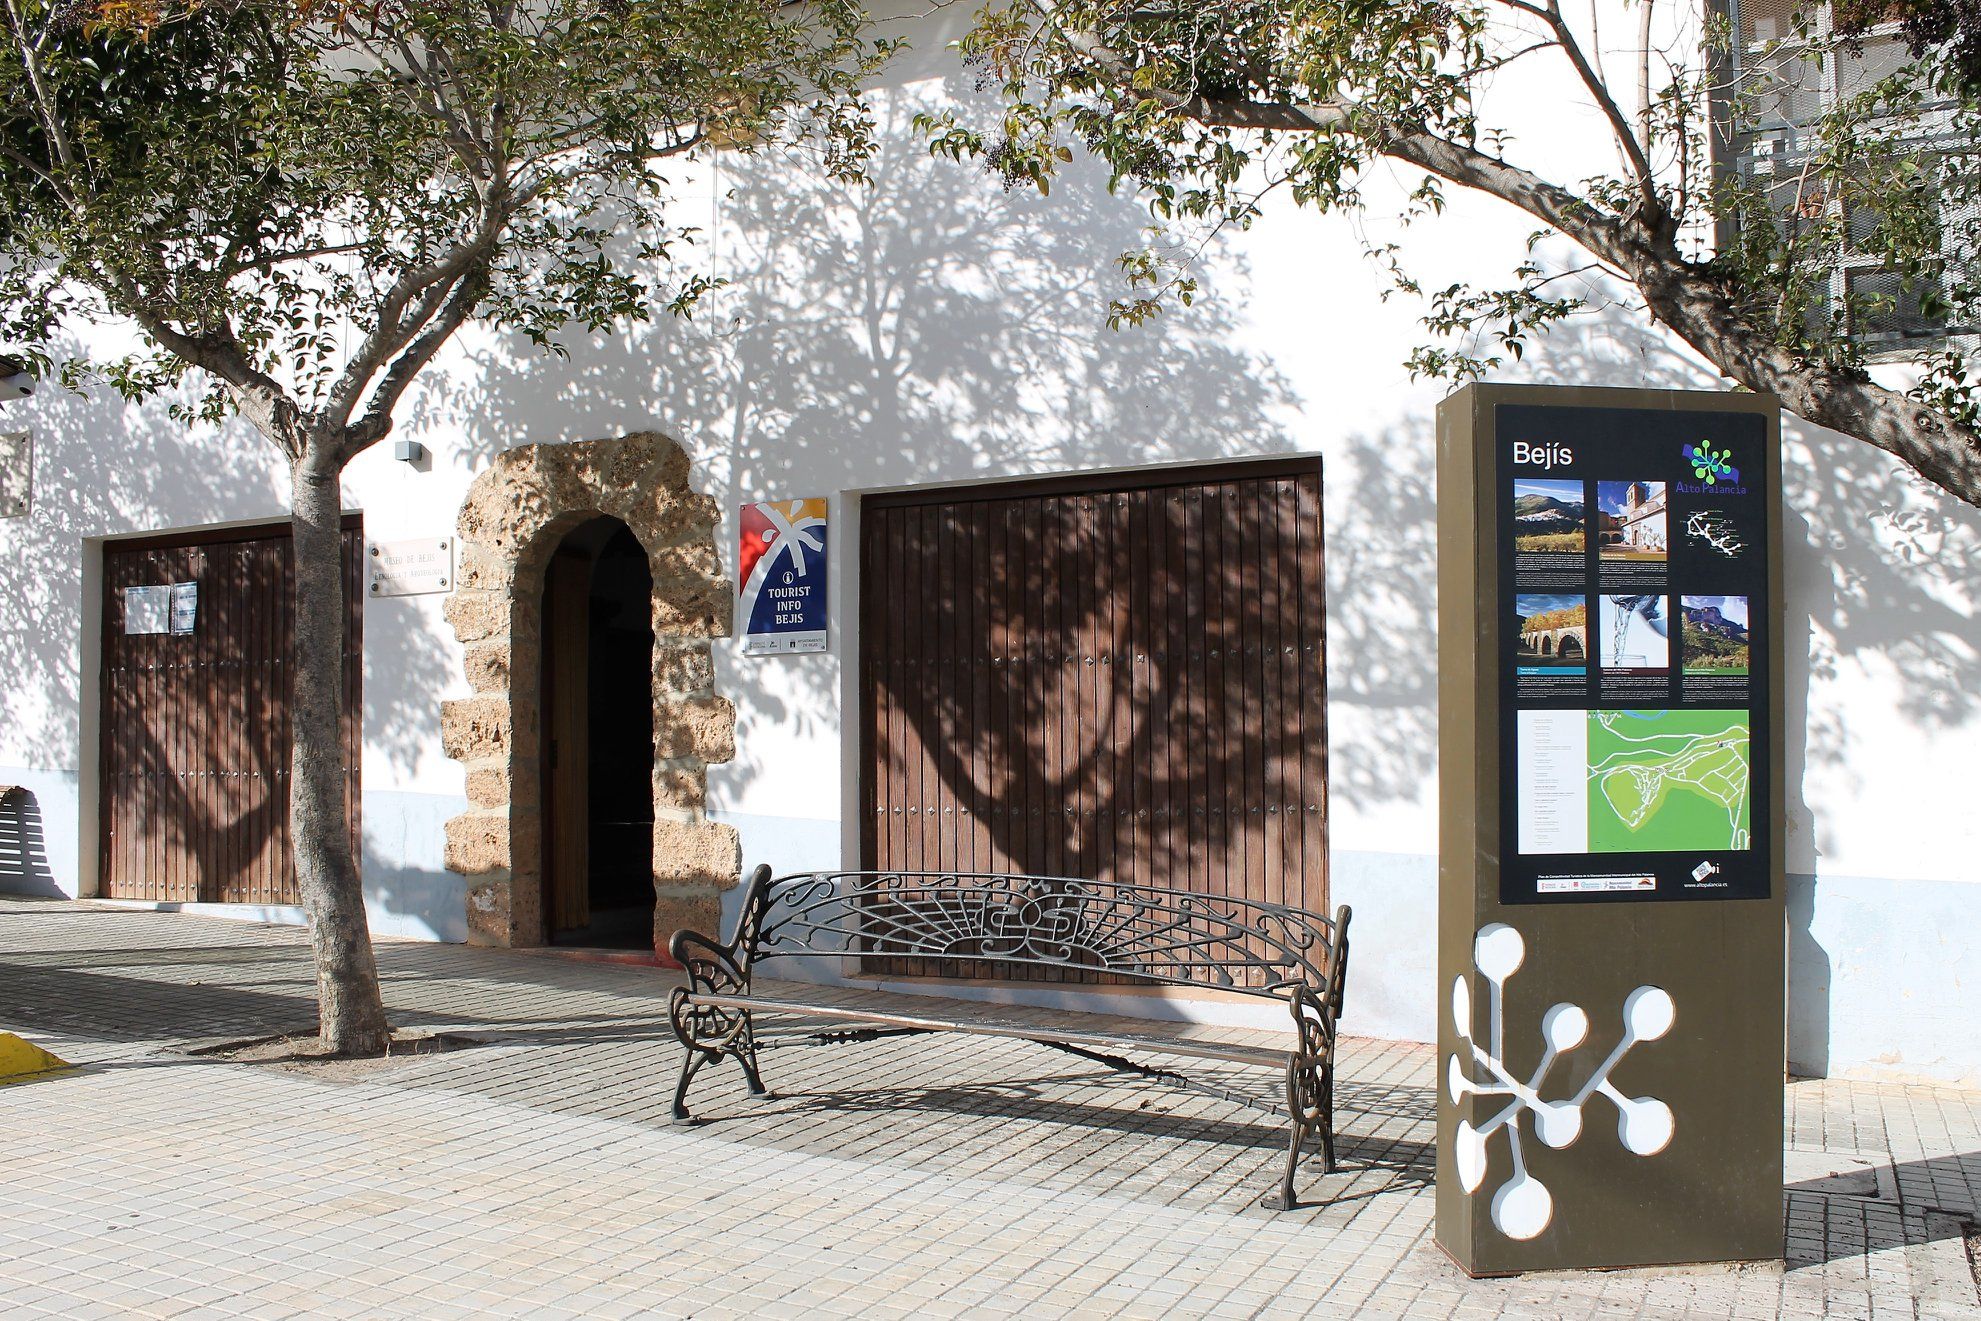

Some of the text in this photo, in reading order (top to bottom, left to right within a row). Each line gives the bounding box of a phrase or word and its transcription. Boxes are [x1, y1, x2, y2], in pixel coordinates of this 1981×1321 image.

[1513, 441, 1573, 470] Bejís
[1675, 480, 1747, 494] Alto Palancia
[768, 586, 810, 598] TOURIST
[777, 600, 801, 611] INFO
[775, 614, 804, 624] BEJIS
